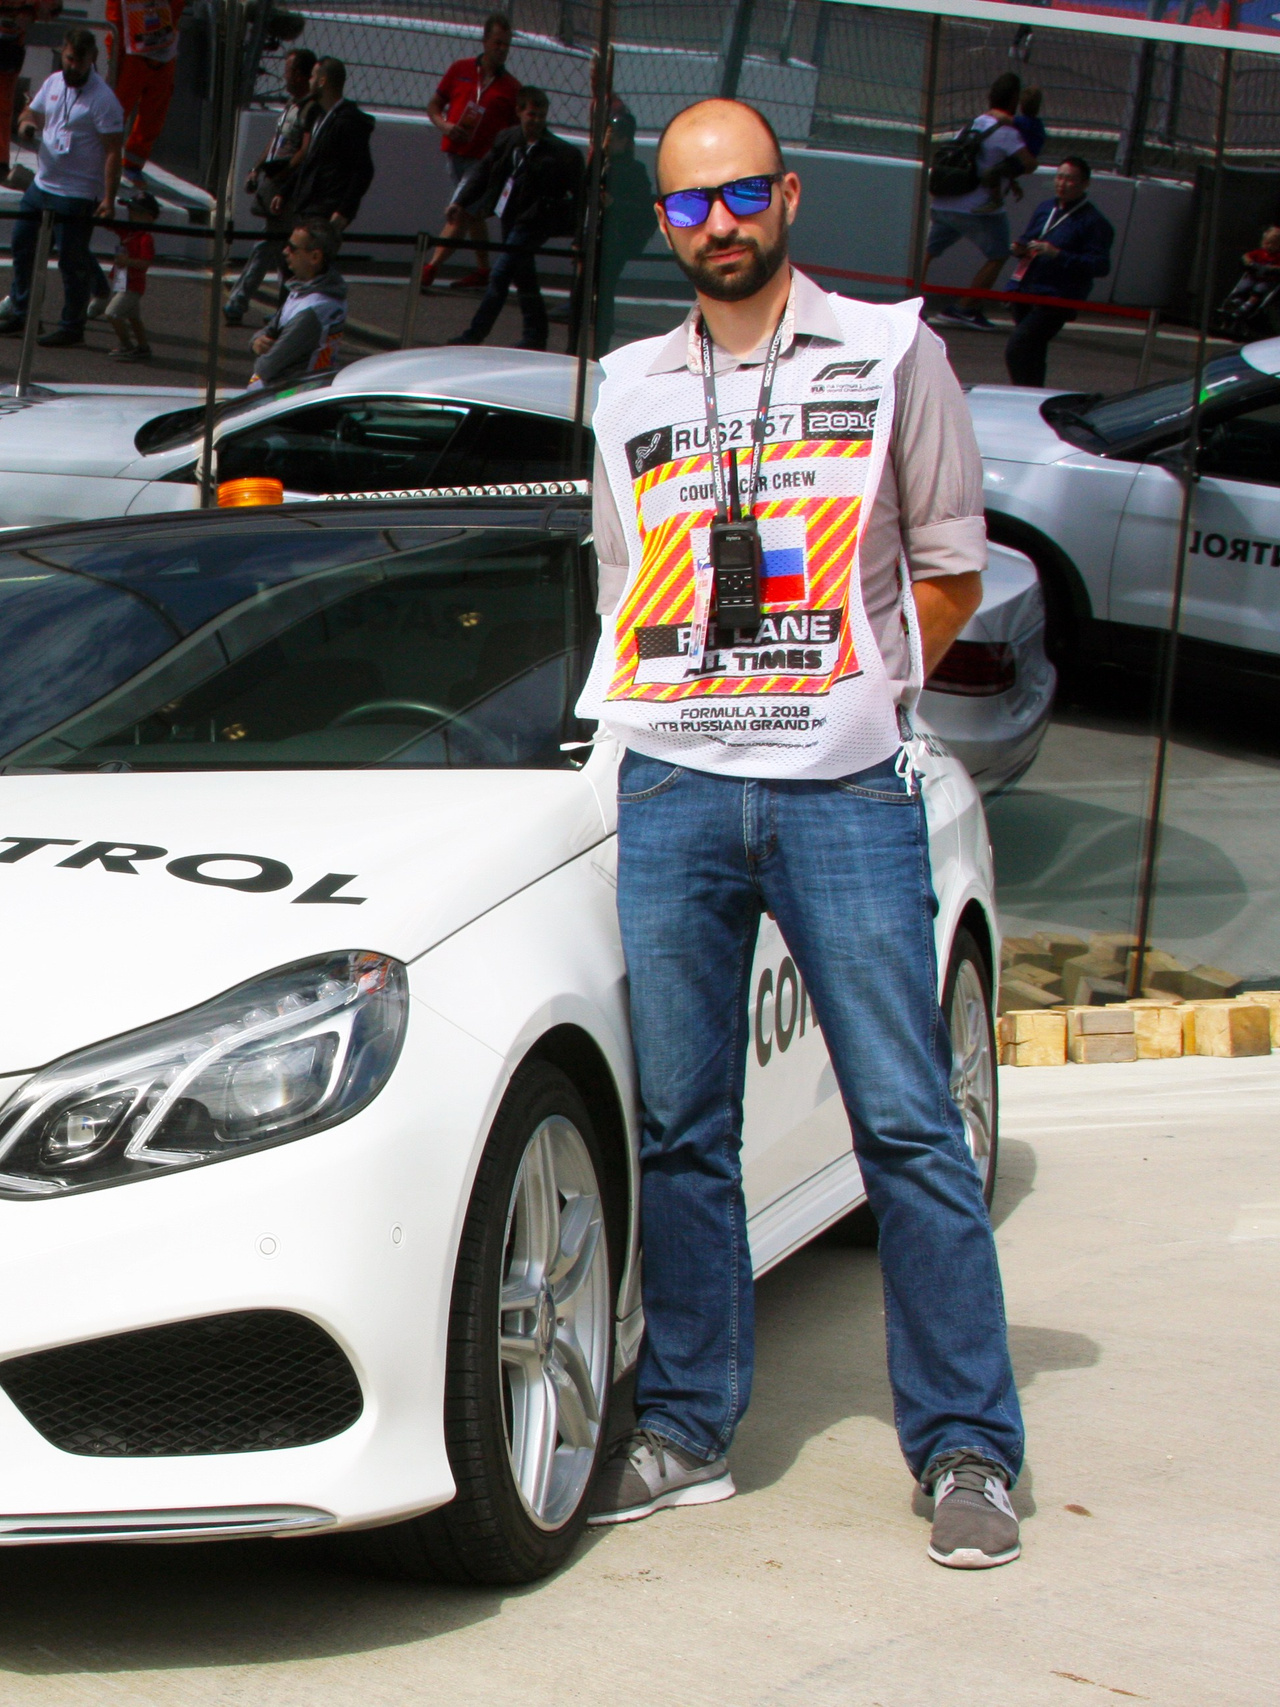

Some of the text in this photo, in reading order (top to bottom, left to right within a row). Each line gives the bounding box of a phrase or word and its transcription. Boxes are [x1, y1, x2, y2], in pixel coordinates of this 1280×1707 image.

[772, 470, 816, 489] CREW
[732, 614, 832, 645] LANE
[732, 649, 823, 672] TIMES
[680, 705, 810, 720] FORMULA 1 2018
[681, 719, 747, 733] RUSSIAN
[750, 719, 810, 732] GRAND
